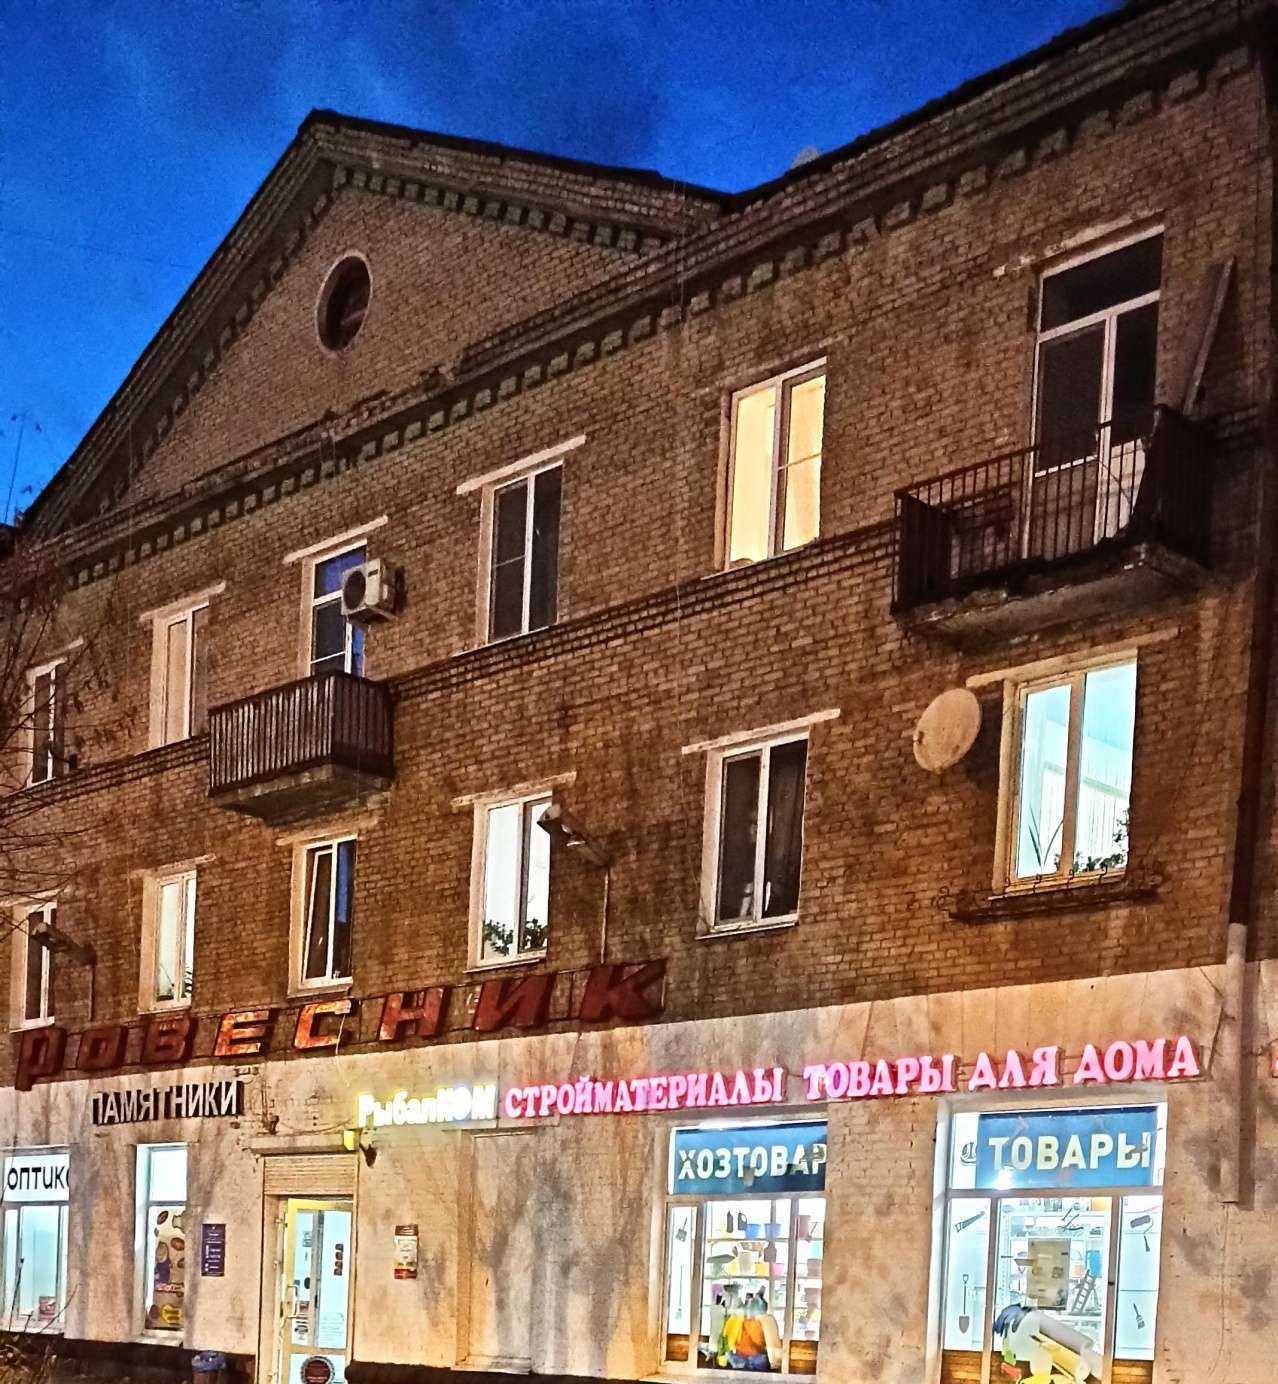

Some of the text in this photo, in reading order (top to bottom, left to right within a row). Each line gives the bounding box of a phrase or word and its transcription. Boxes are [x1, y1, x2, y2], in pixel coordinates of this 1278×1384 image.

[503, 1035, 1200, 1118] СТРОЙМАТЕРИАЛЫ ТОВАРЫ ДЛЯ ДОМА
[89, 1080, 242, 1126] ПАМЯТНИКИ
[678, 1143, 827, 1180] ХОЗТОВАР
[988, 1131, 1152, 1171] ТОВАРЫ
[7, 1165, 70, 1190] ОПТИК
